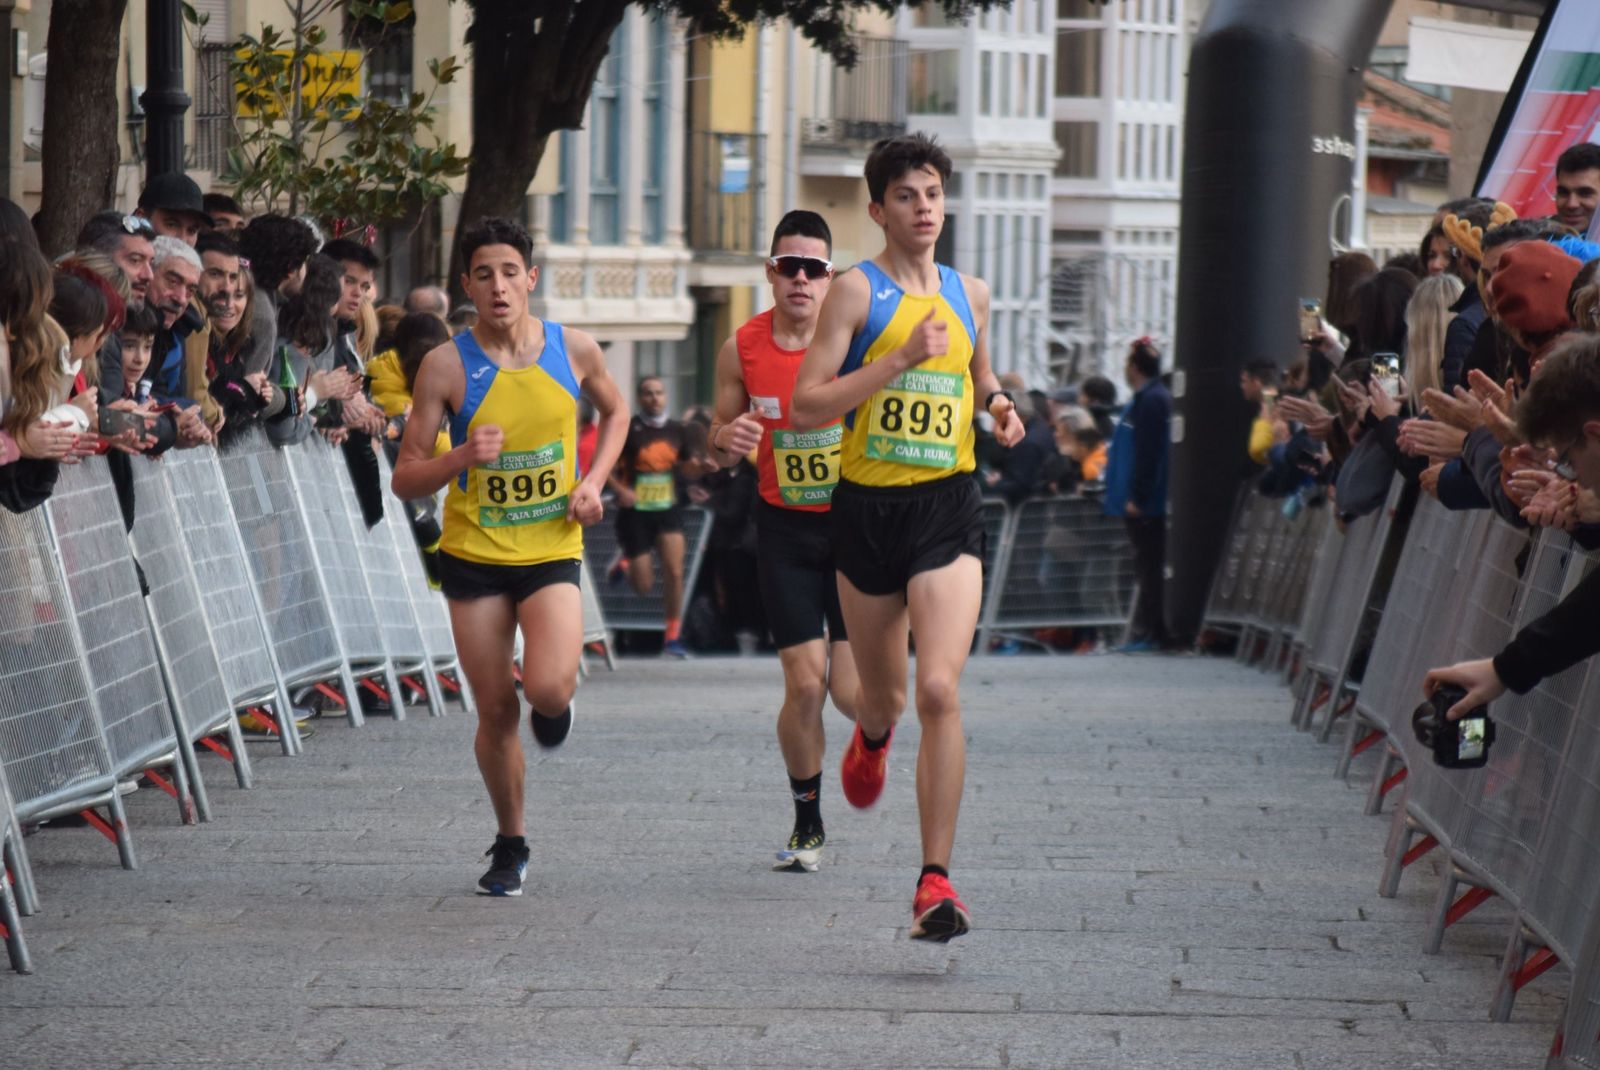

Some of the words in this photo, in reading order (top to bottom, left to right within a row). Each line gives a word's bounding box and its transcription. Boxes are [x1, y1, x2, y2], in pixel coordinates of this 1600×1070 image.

[905, 382, 927, 393] CAJA
[929, 384, 954, 396] RURAL
[880, 396, 953, 439] 893
[797, 440, 817, 449] CAJA
[895, 444, 921, 459] CAJA
[924, 448, 953, 464] RURAL
[502, 461, 524, 470] CAJA
[526, 456, 554, 468] RURAL
[487, 469, 557, 505] 896
[804, 490, 828, 500] CAJA
[506, 511, 531, 521] CAJA
[532, 502, 565, 518] RURAL
